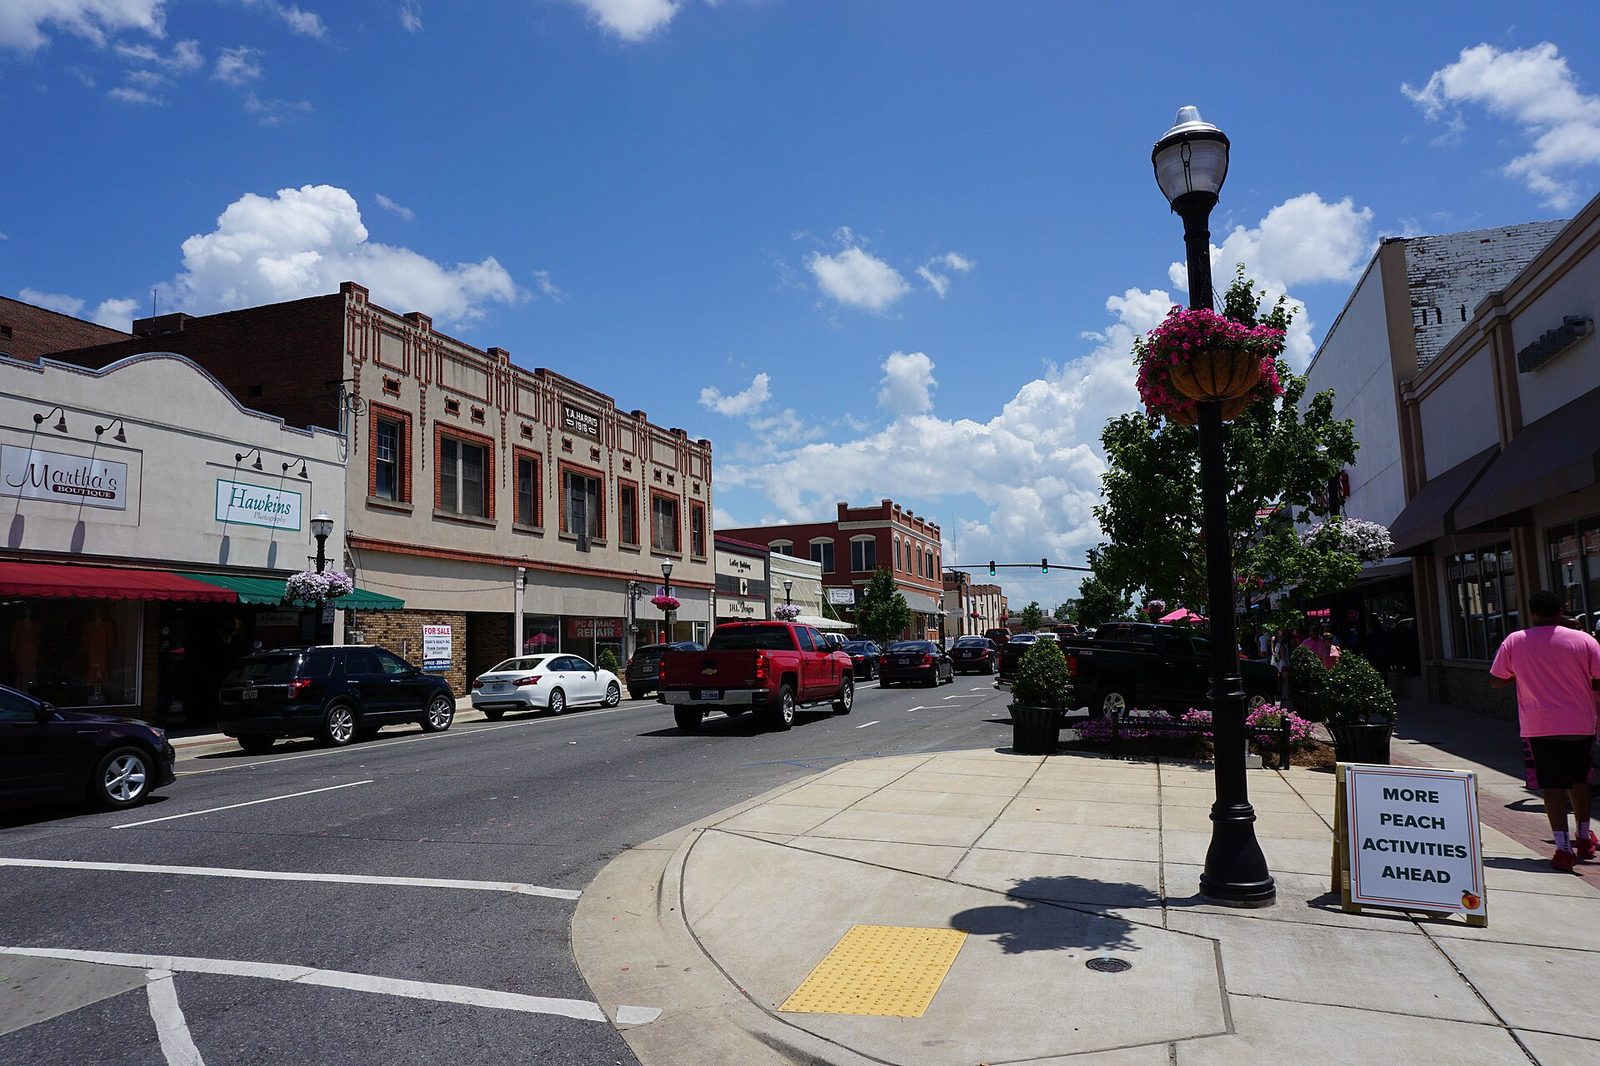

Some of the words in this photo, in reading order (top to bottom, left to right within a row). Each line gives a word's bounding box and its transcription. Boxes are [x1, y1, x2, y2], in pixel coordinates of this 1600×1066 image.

[6, 463, 117, 491] Martha's
[57, 486, 112, 498] BOUTIQUE
[228, 487, 291, 515] Hawkins
[253, 511, 286, 524] Photography
[575, 620, 586, 628] PC
[587, 620, 594, 628] &
[596, 620, 615, 628] MAC
[1383, 787, 1440, 804] MORE
[1380, 812, 1446, 830] PEACH
[1362, 838, 1468, 858] ACTIVITIES
[1382, 866, 1451, 884] AHEAD
